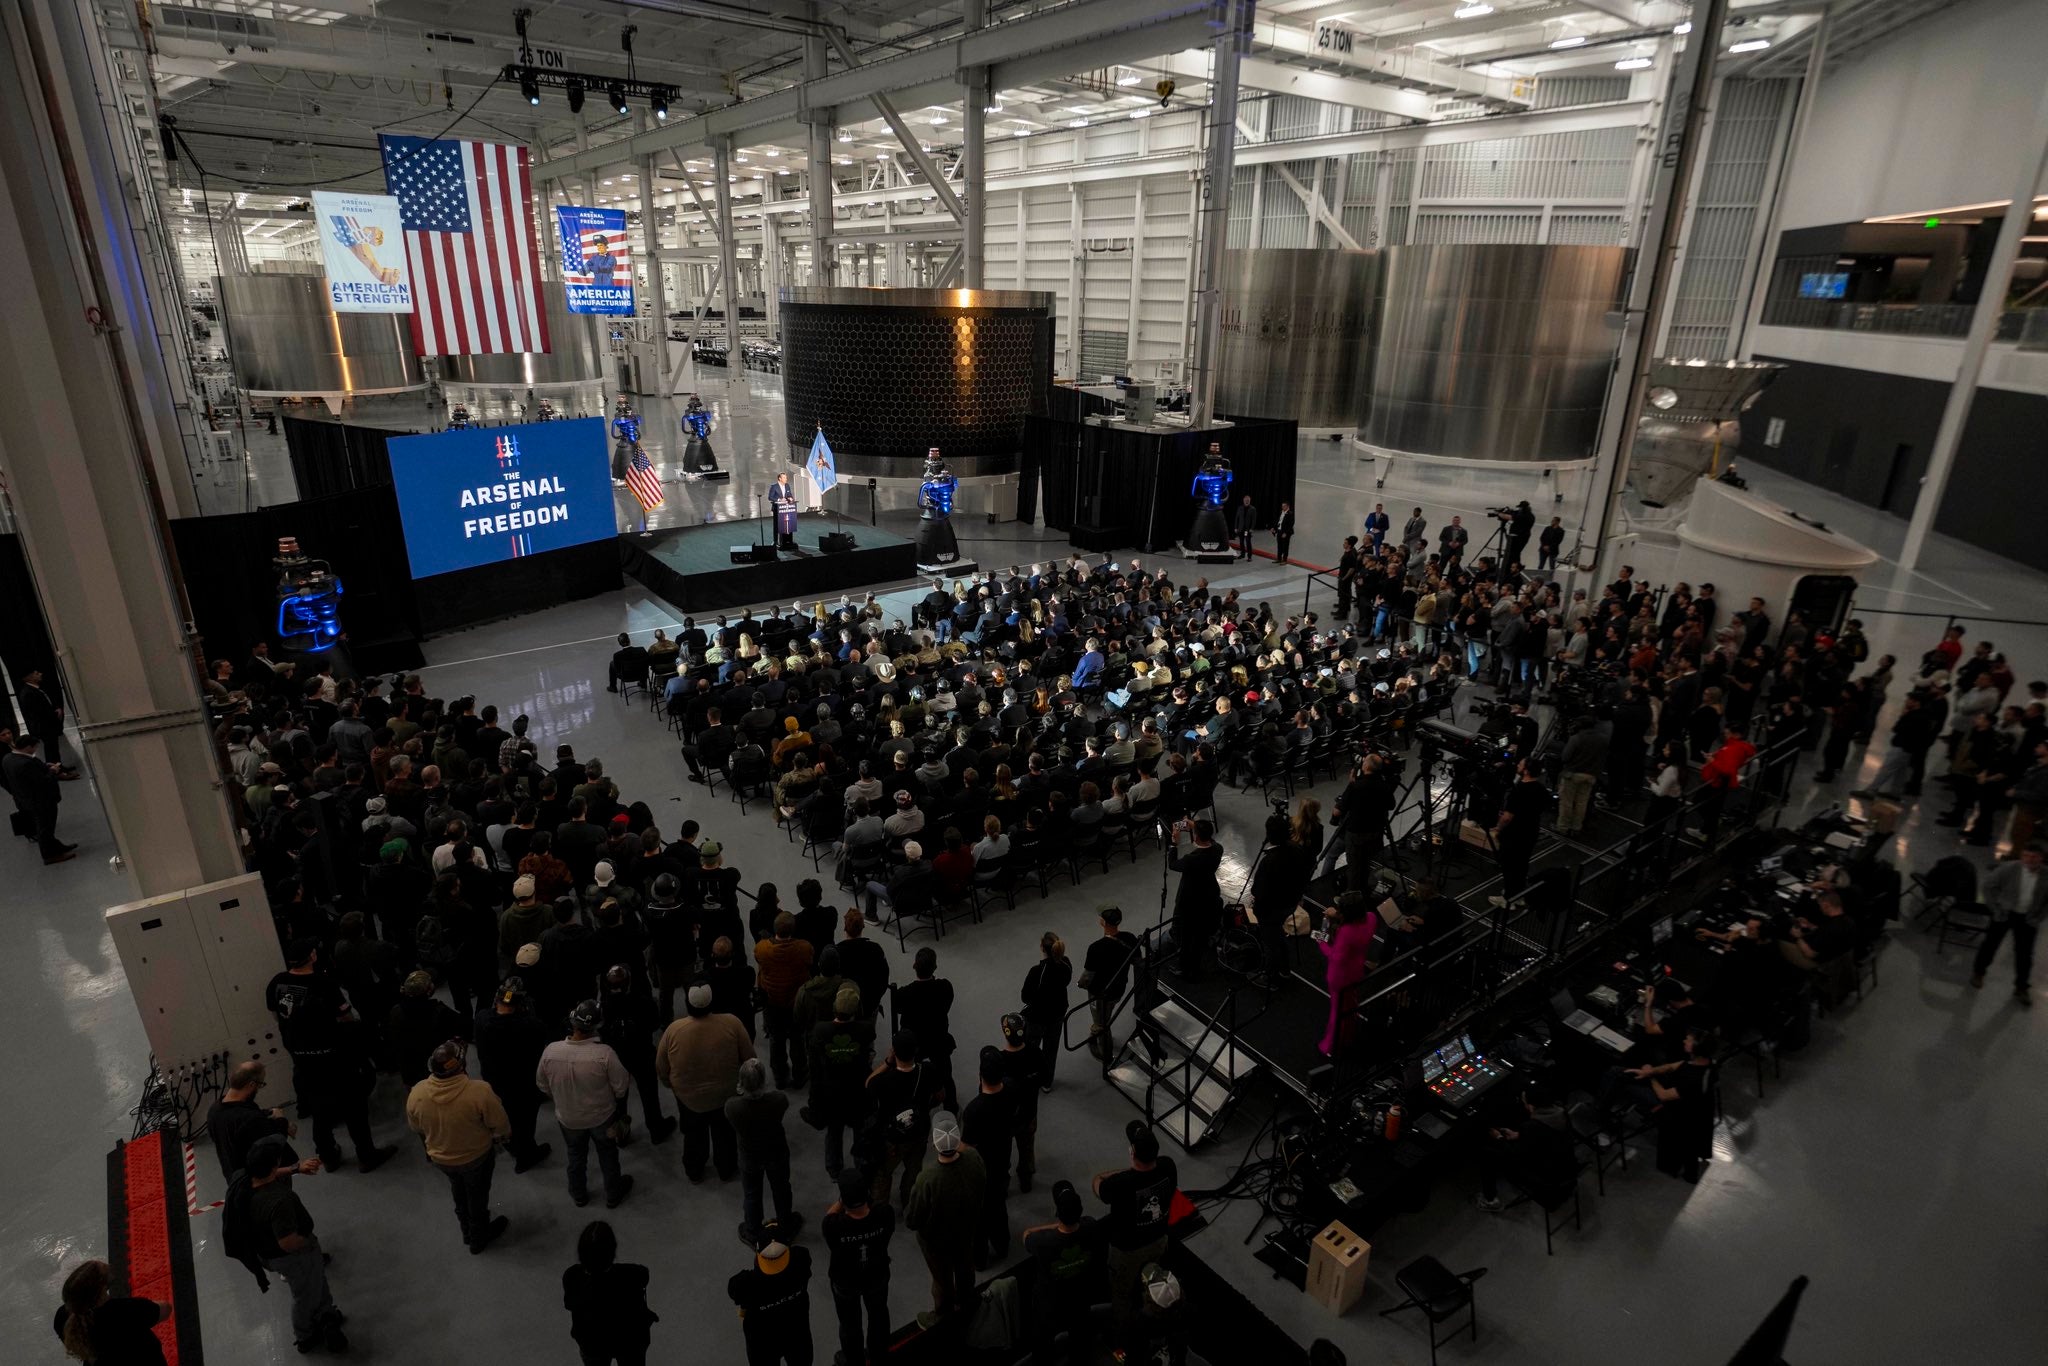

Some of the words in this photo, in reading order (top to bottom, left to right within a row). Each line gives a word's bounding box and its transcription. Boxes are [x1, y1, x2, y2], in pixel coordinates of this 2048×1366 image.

[1319, 26, 1331, 48] 25
[1333, 29, 1353, 53] TON
[536, 48, 564, 68] TON
[332, 282, 408, 294] AMERICAN
[569, 288, 631, 299] AMERICAN
[334, 292, 410, 304] STRENGTH
[569, 299, 632, 307] MANUFACTURING
[503, 471, 520, 480] THE
[460, 476, 566, 508] ARSENAL
[510, 501, 522, 510] OF
[464, 504, 569, 538] FREEDOM
